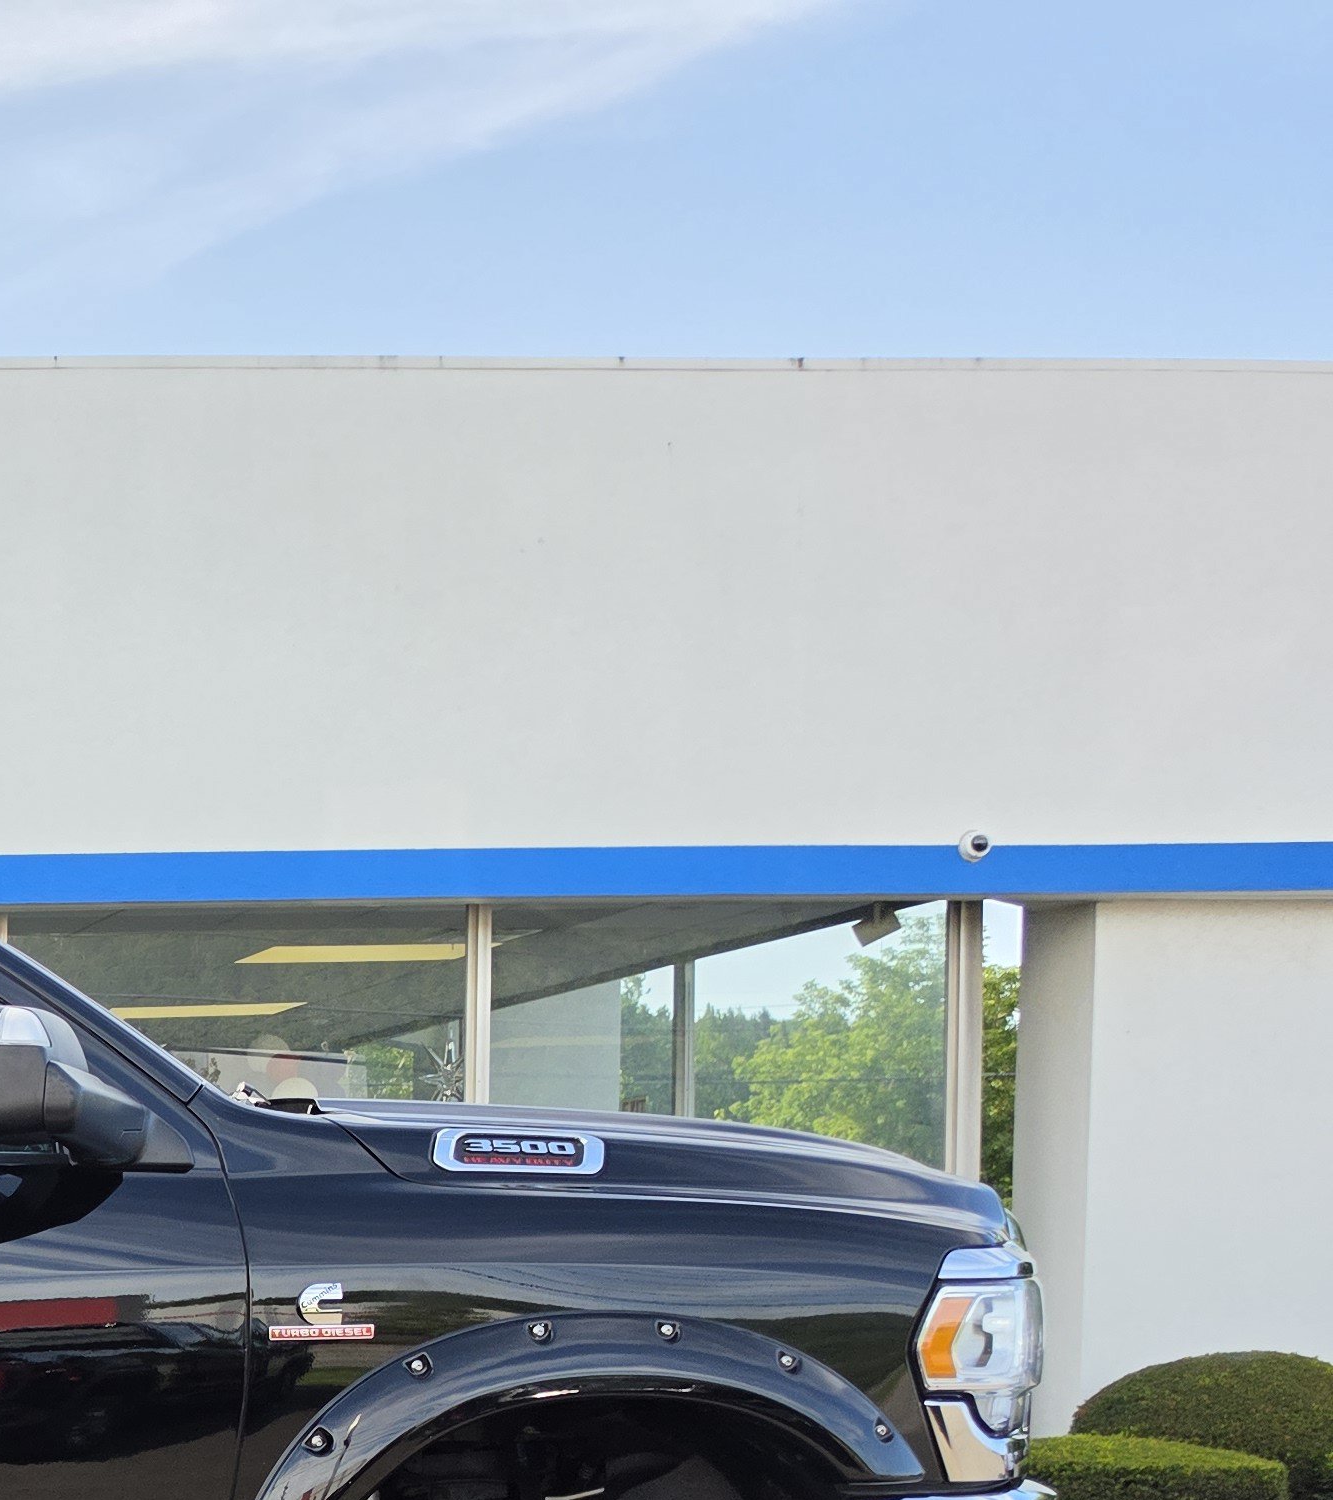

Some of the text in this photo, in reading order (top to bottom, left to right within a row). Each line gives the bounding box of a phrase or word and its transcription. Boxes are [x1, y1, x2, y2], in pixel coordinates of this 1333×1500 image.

[464, 1139, 576, 1155] 3500
[300, 1284, 338, 1308] Cummins
[272, 1327, 372, 1338] TURBO DIESEL
